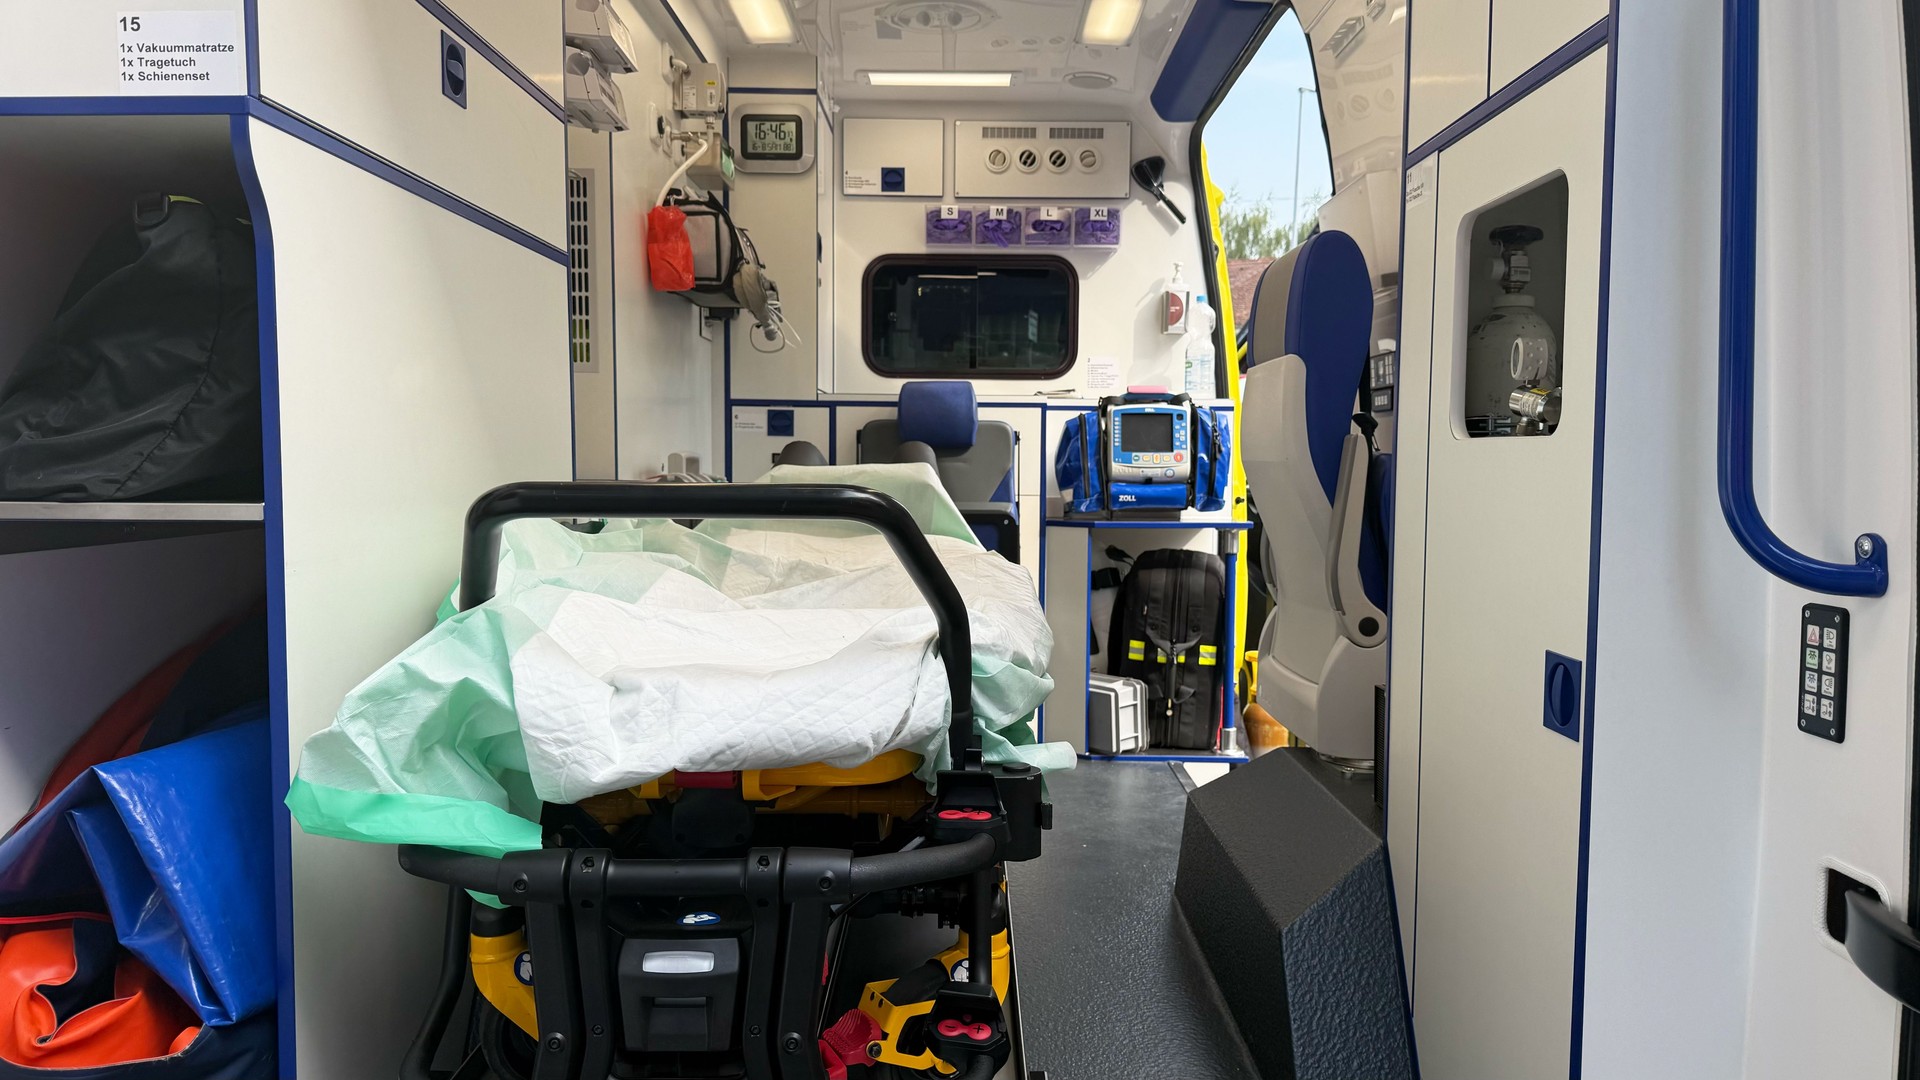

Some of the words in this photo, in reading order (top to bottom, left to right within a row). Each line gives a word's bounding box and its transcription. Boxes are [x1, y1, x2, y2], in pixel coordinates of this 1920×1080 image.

[119, 16, 141, 32] 15
[120, 43, 133, 53] 1x
[136, 43, 235, 53] Vakuummatratze
[120, 57, 134, 67] 1x
[137, 57, 196, 69] Tragetuch
[121, 71, 134, 81] 1x
[138, 71, 210, 81] Schienenset
[754, 122, 787, 141] 16:46
[947, 208, 953, 216] S
[996, 208, 1004, 216] M
[1046, 209, 1052, 217] L
[1094, 209, 1106, 217] XL
